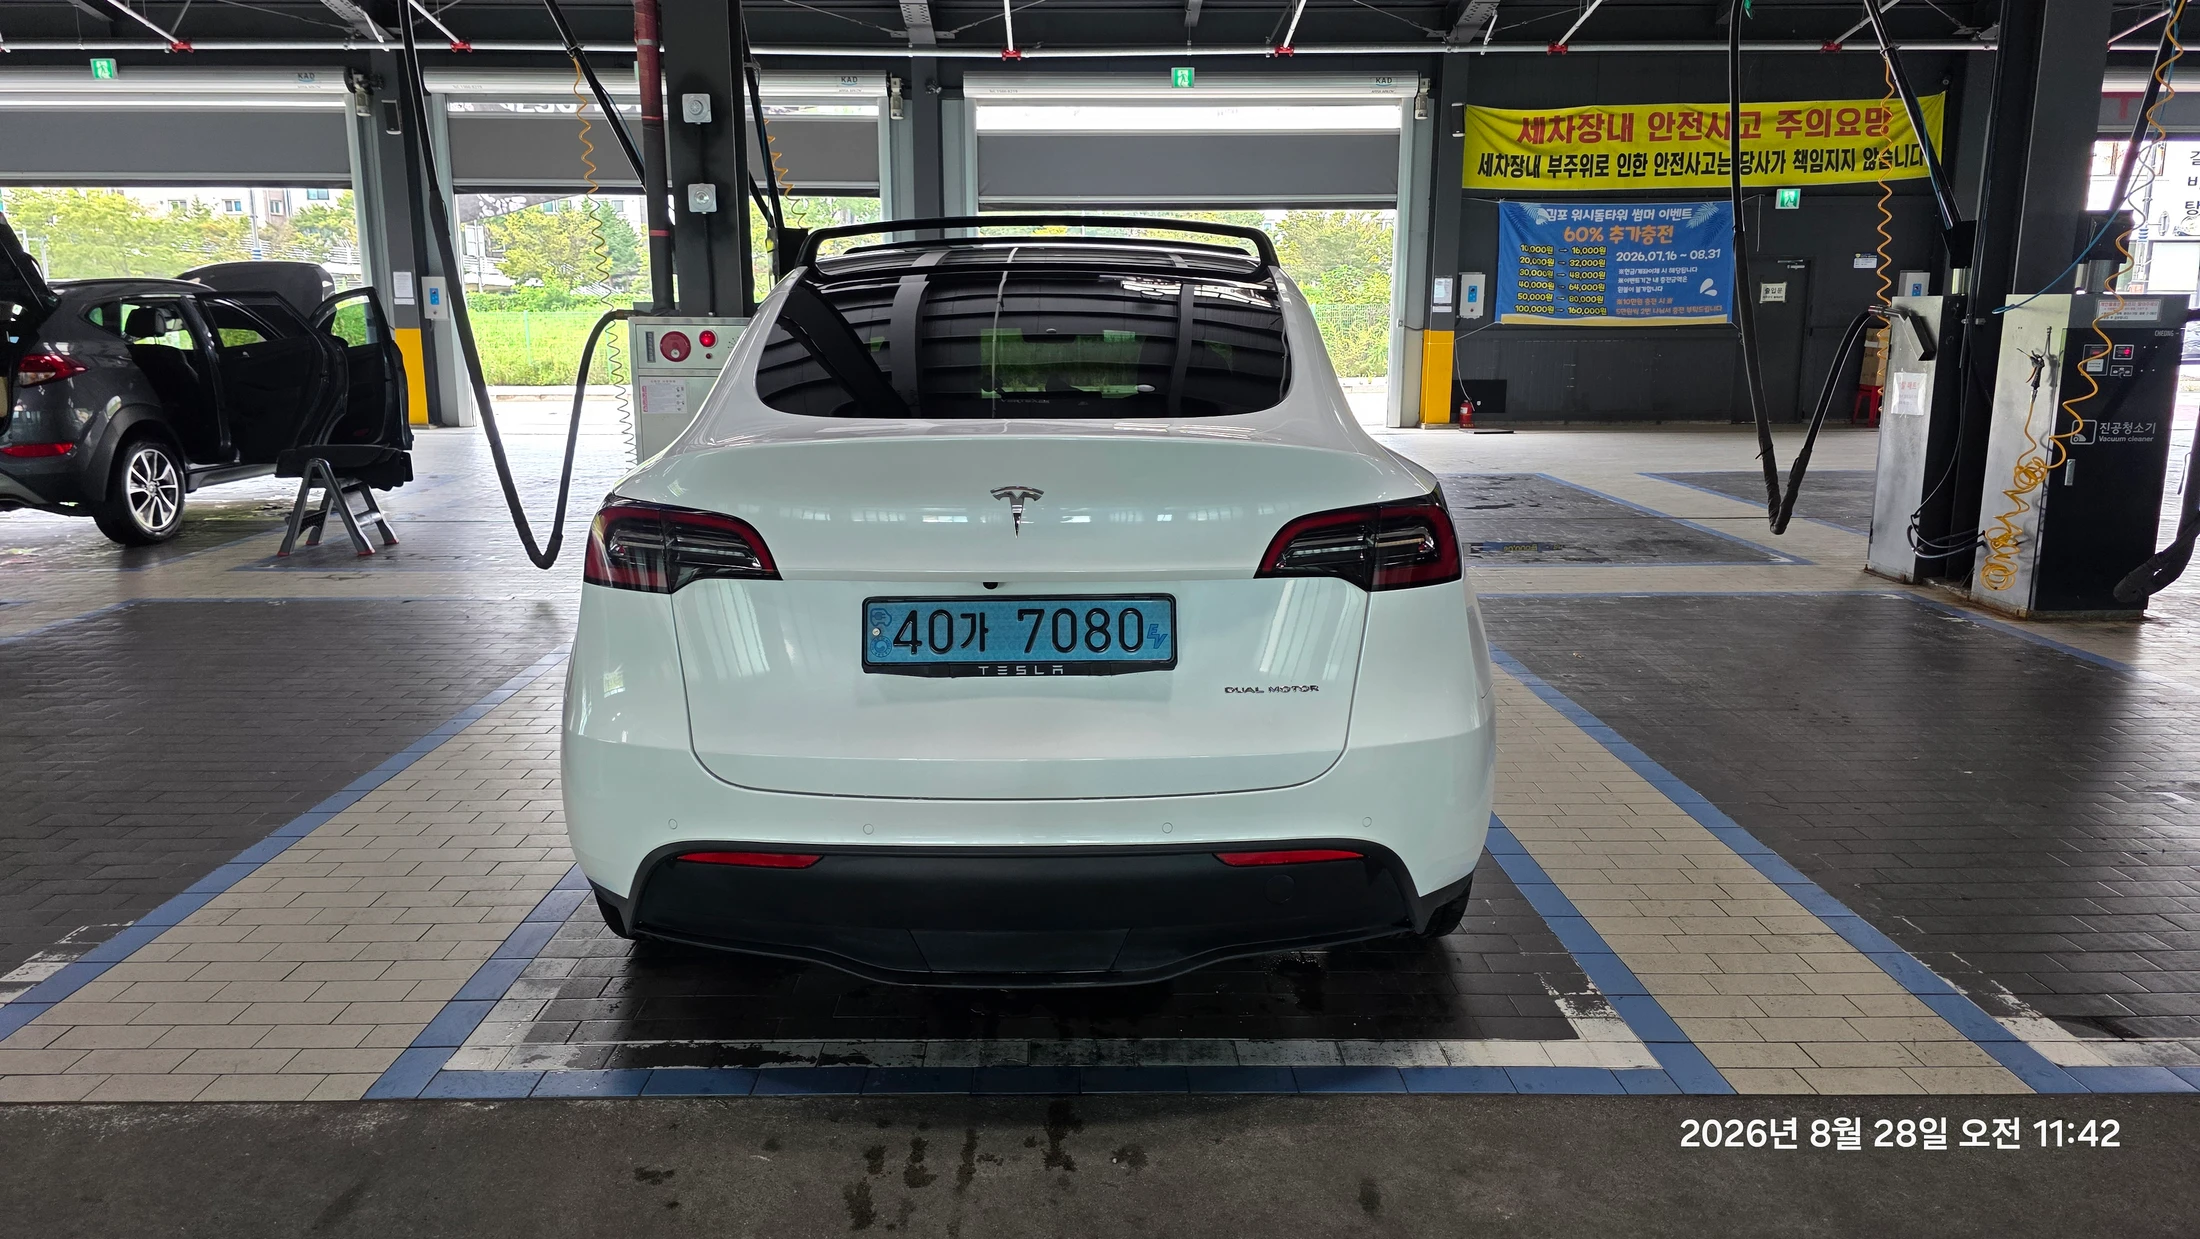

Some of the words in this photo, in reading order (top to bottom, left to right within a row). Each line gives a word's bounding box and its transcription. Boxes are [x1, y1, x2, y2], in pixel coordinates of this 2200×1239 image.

[1516, 112, 1635, 145] 세차장내
[1647, 111, 1762, 142] 안전사고
[1775, 107, 1891, 139] 주의요망
[1477, 152, 1542, 179] 세차장내
[1547, 153, 1610, 179] 부주위로
[1616, 152, 1648, 178] 인한
[1653, 151, 1732, 177] 안전사고는
[1739, 150, 1786, 175] 당사가
[1792, 147, 1855, 174] 책임지지
[1862, 143, 1925, 172] 않습니다
[1547, 209, 1568, 221] 김포
[1571, 209, 1629, 223] 워시돔타워
[1631, 208, 1656, 222] 썸머
[1658, 208, 1693, 221] 이벤트
[1563, 226, 1604, 243] 60%
[1609, 225, 1675, 245] 추가충전
[1520, 244, 1554, 255] 10,000원
[1571, 246, 1607, 255] 16,000원
[1616, 251, 1677, 262] 2026.07.16
[1689, 248, 1721, 260] 08.31
[1519, 256, 1555, 267] 20,000원
[1569, 258, 1606, 267] 32,000원
[1519, 268, 1554, 278] 30,000원
[1569, 271, 1606, 280] 48,000원
[1518, 281, 1555, 291] 40,000원
[1568, 283, 1605, 292] 64,000원
[1517, 292, 1553, 302] 50,000원
[1568, 295, 1604, 304] 80,000원
[1515, 305, 1555, 314] 100,000원
[1567, 307, 1607, 316] 160,000원
[2099, 422, 2156, 435] 진공청소기
[893, 609, 989, 655] 40가
[1017, 607, 1144, 654] 7080
[1147, 623, 1168, 649] EV
[977, 665, 1064, 676] TESLA
[1224, 686, 1265, 694] DUAL
[1268, 685, 1320, 693] MOTOR
